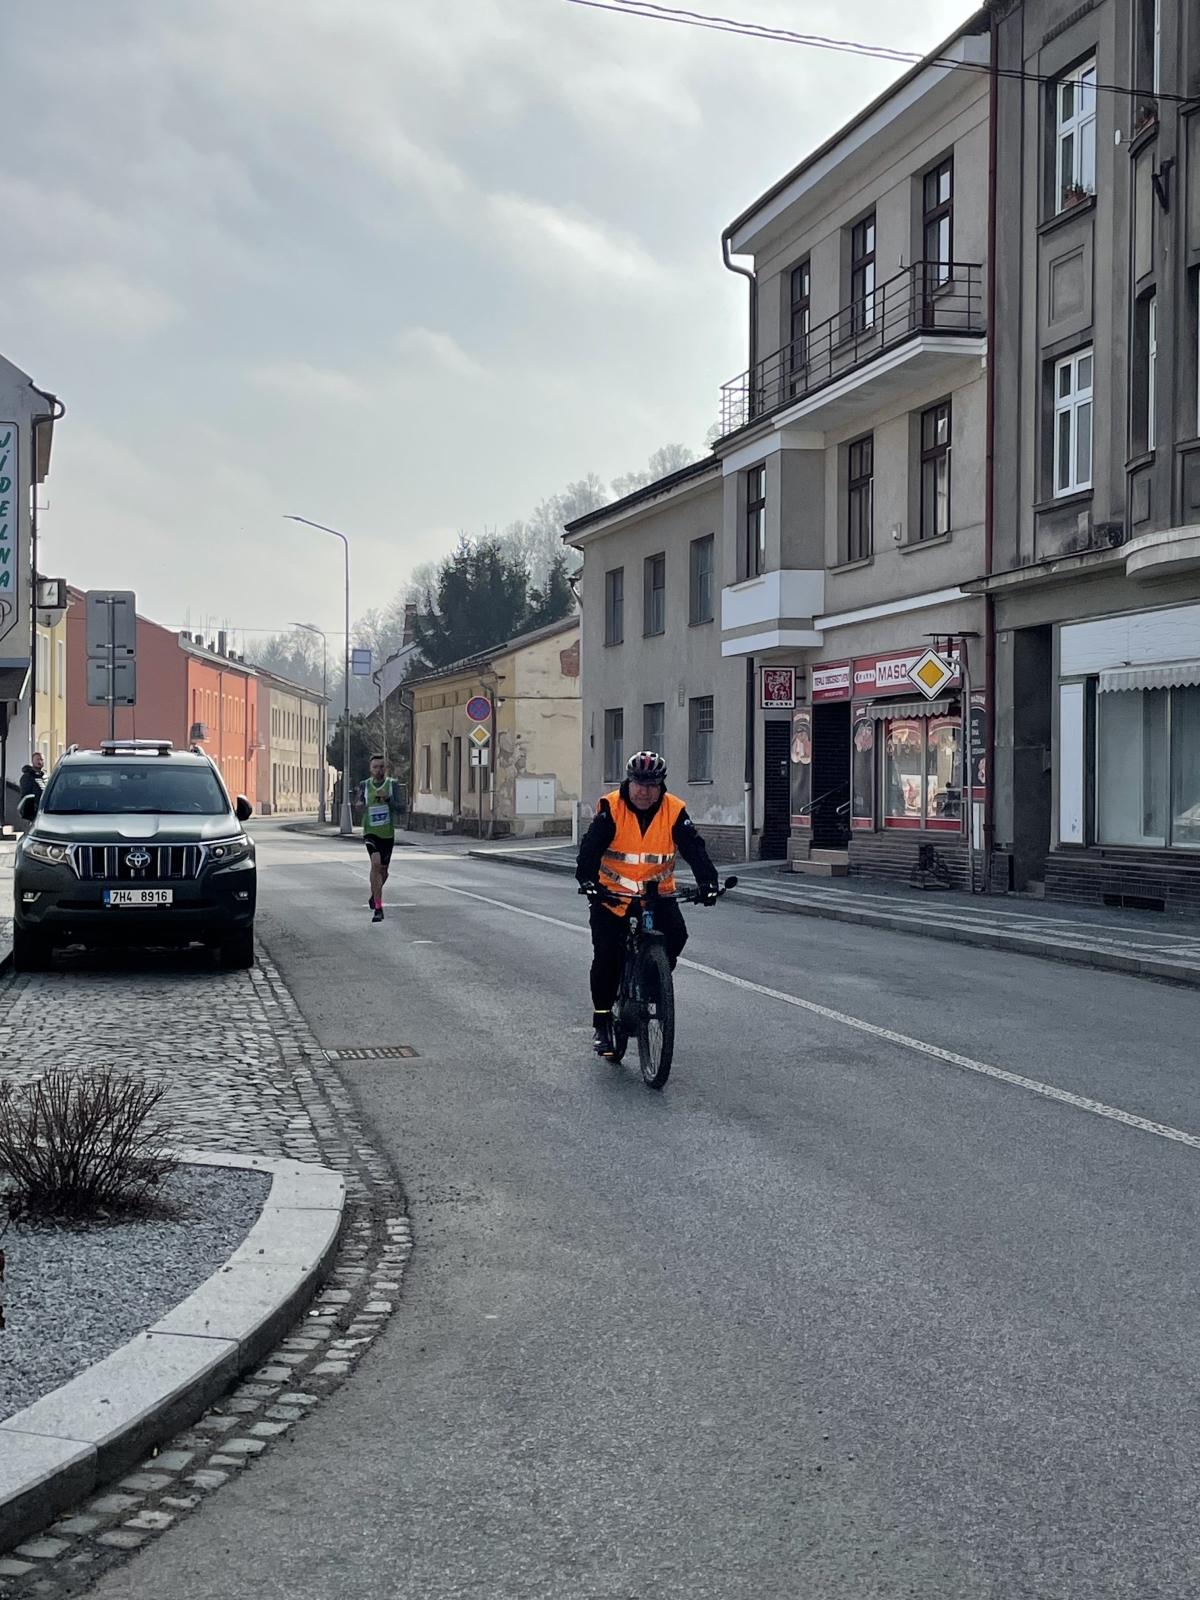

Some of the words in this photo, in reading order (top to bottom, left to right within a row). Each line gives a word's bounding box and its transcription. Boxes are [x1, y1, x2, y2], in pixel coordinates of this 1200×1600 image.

[878, 663, 907, 681] MASO
[112, 891, 132, 902] 7H4
[141, 891, 168, 902] 8916
